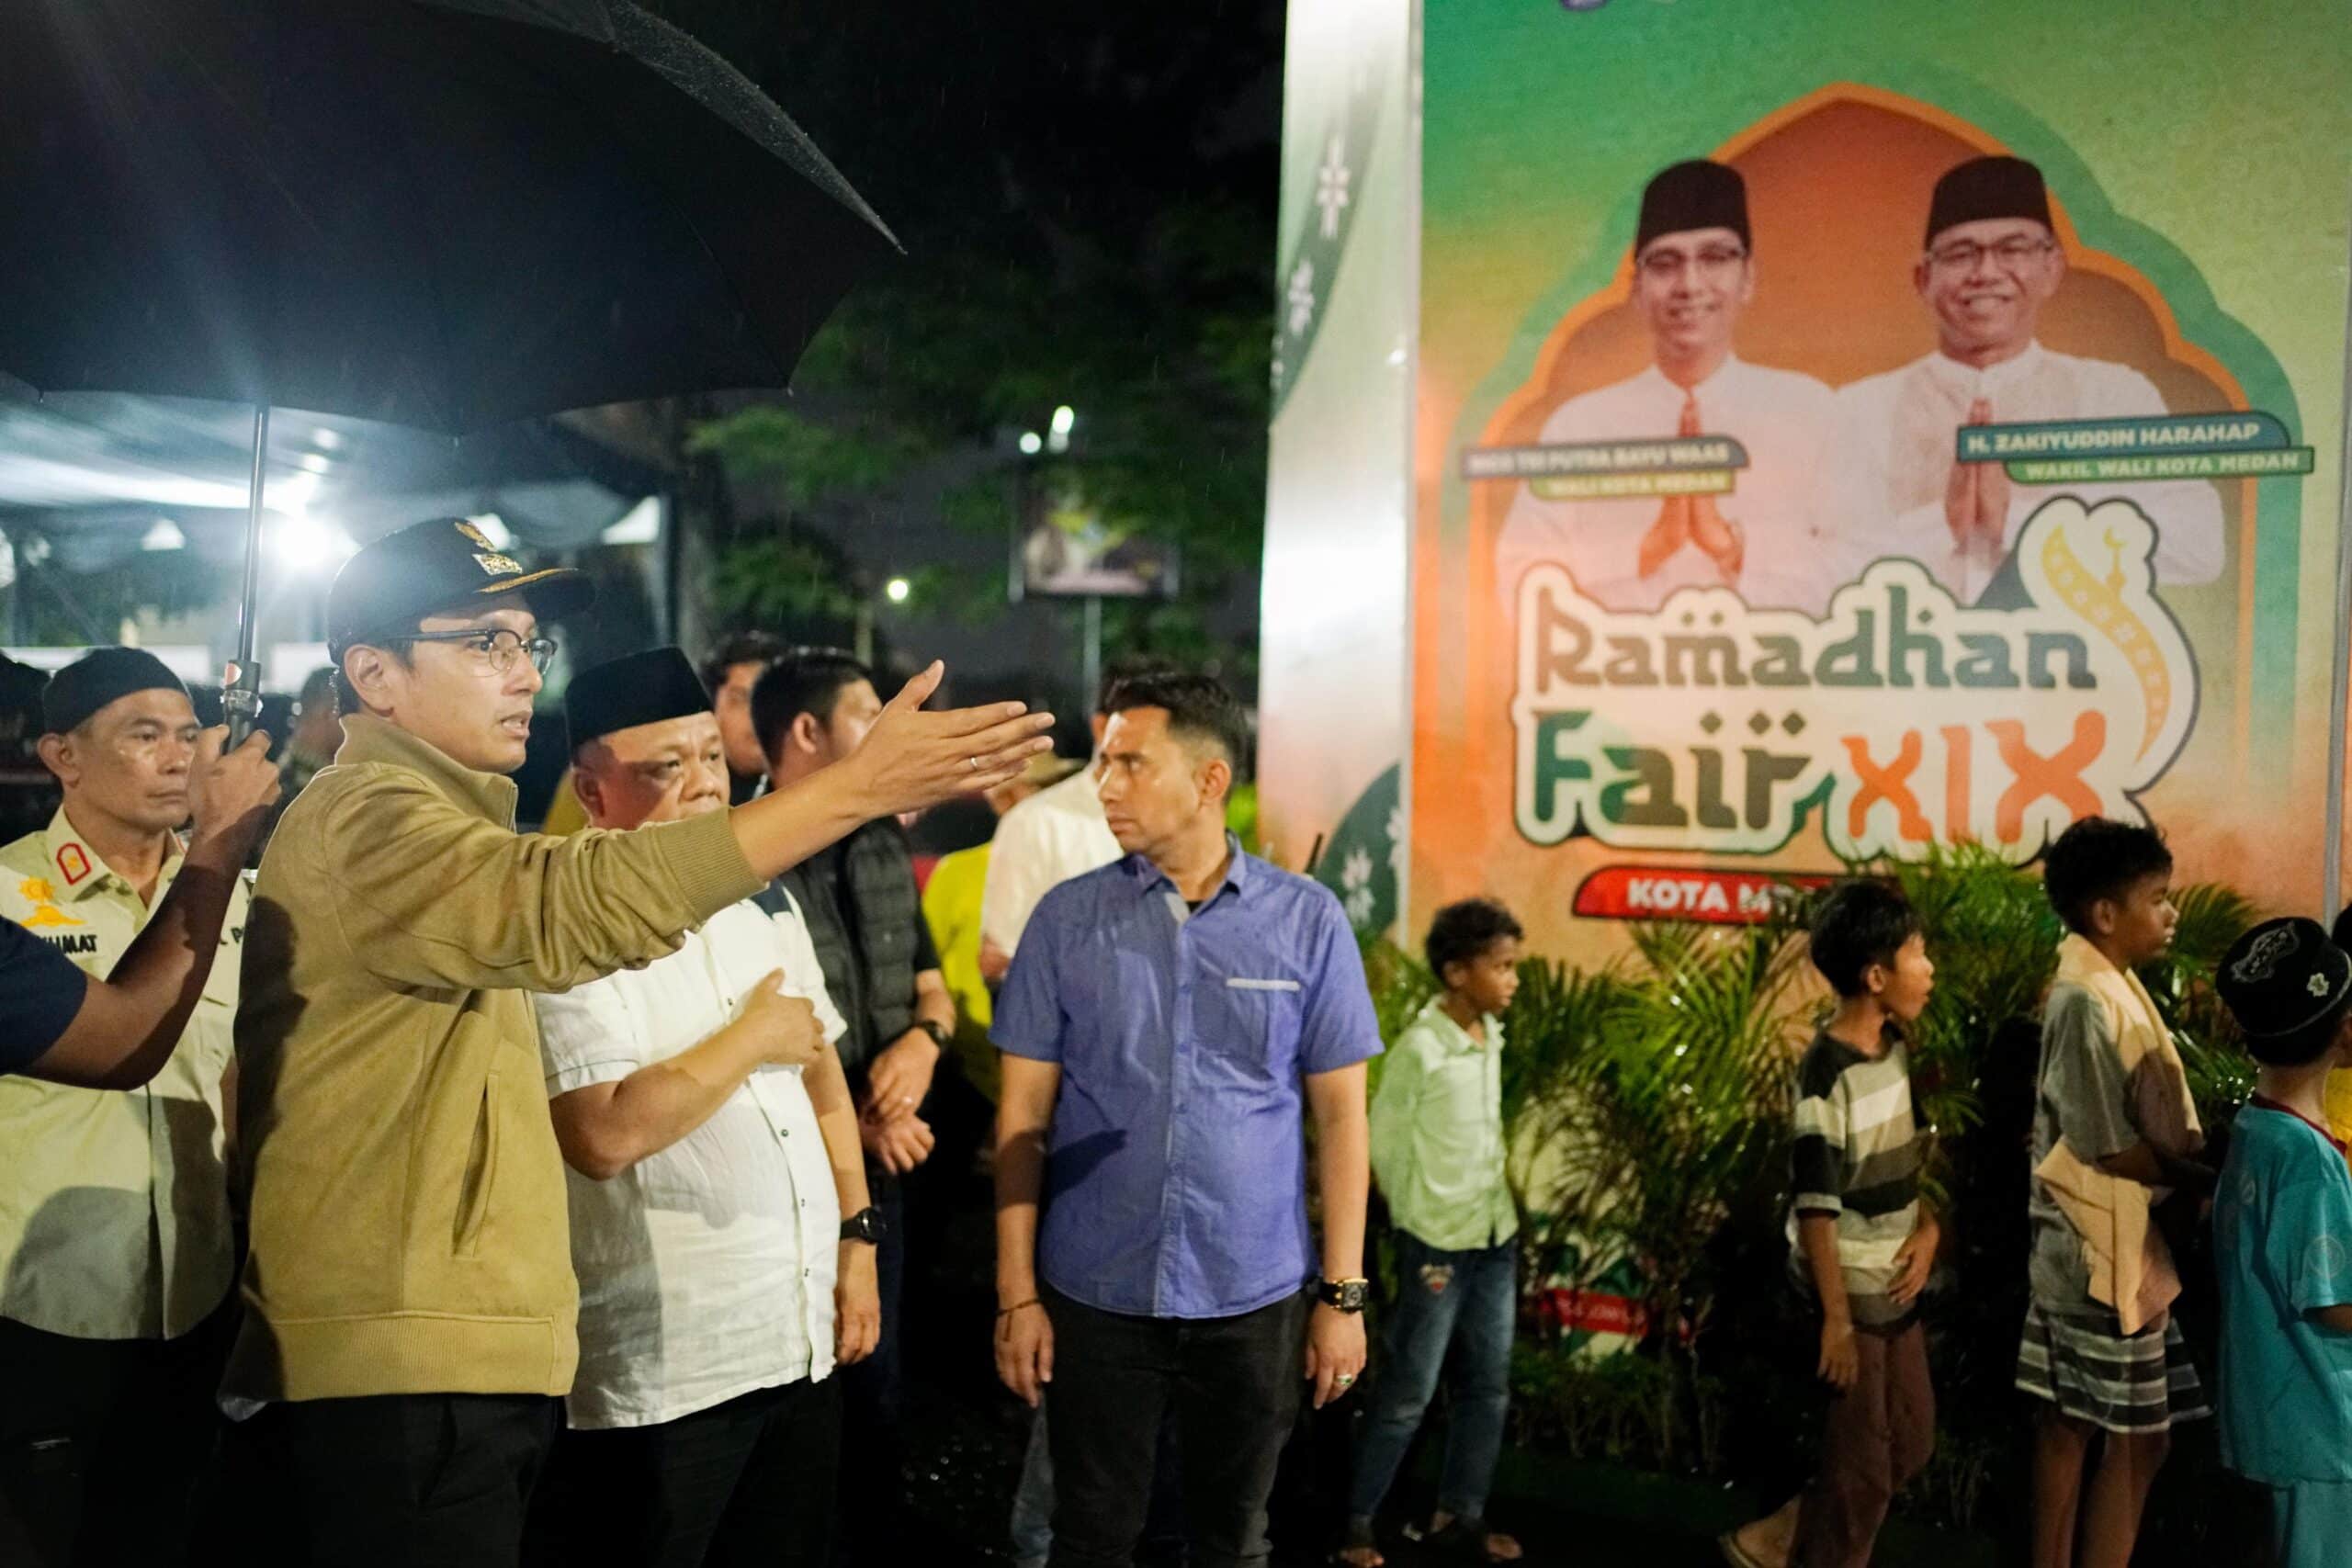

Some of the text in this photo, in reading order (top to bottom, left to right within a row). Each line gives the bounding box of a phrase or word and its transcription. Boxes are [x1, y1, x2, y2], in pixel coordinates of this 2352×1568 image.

[1995, 429, 2136, 453] ZAKIYUDDIN
[2141, 423, 2260, 446] HARAHAP
[1548, 447, 1609, 470] PUTRA
[1668, 441, 1729, 466] WAAS
[2025, 453, 2299, 479] WAKIL WALI KOTA MEDAN
[1550, 471, 1727, 495] WALI KOTA MEDAN
[1535, 583, 2098, 695] Ramadhan
[1532, 709, 2107, 843] Fair XIX
[1627, 878, 1729, 912] KOTA
